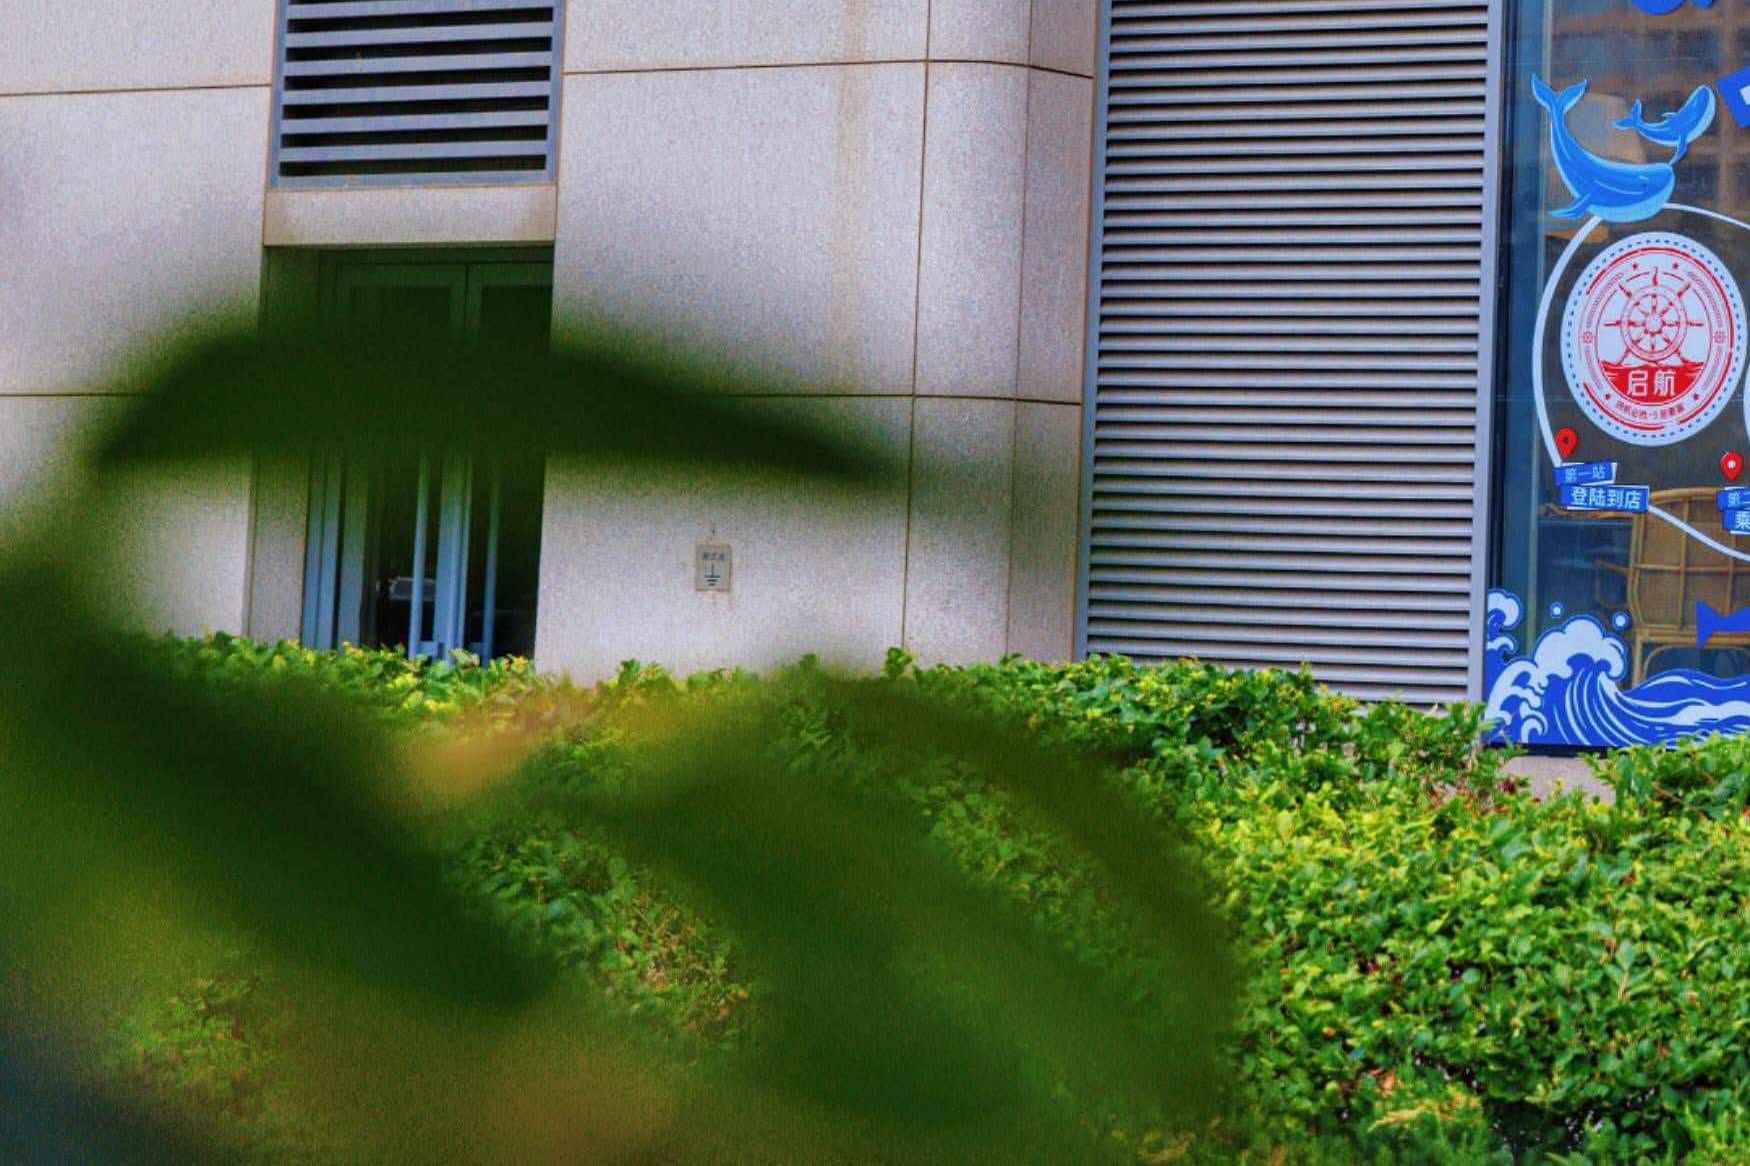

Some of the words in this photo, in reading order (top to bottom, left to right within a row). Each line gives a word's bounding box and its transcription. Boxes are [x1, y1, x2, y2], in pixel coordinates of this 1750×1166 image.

[1627, 369, 1675, 396] 启航
[1564, 465, 1605, 482] 第一站
[1570, 487, 1642, 510] 登陆到店
